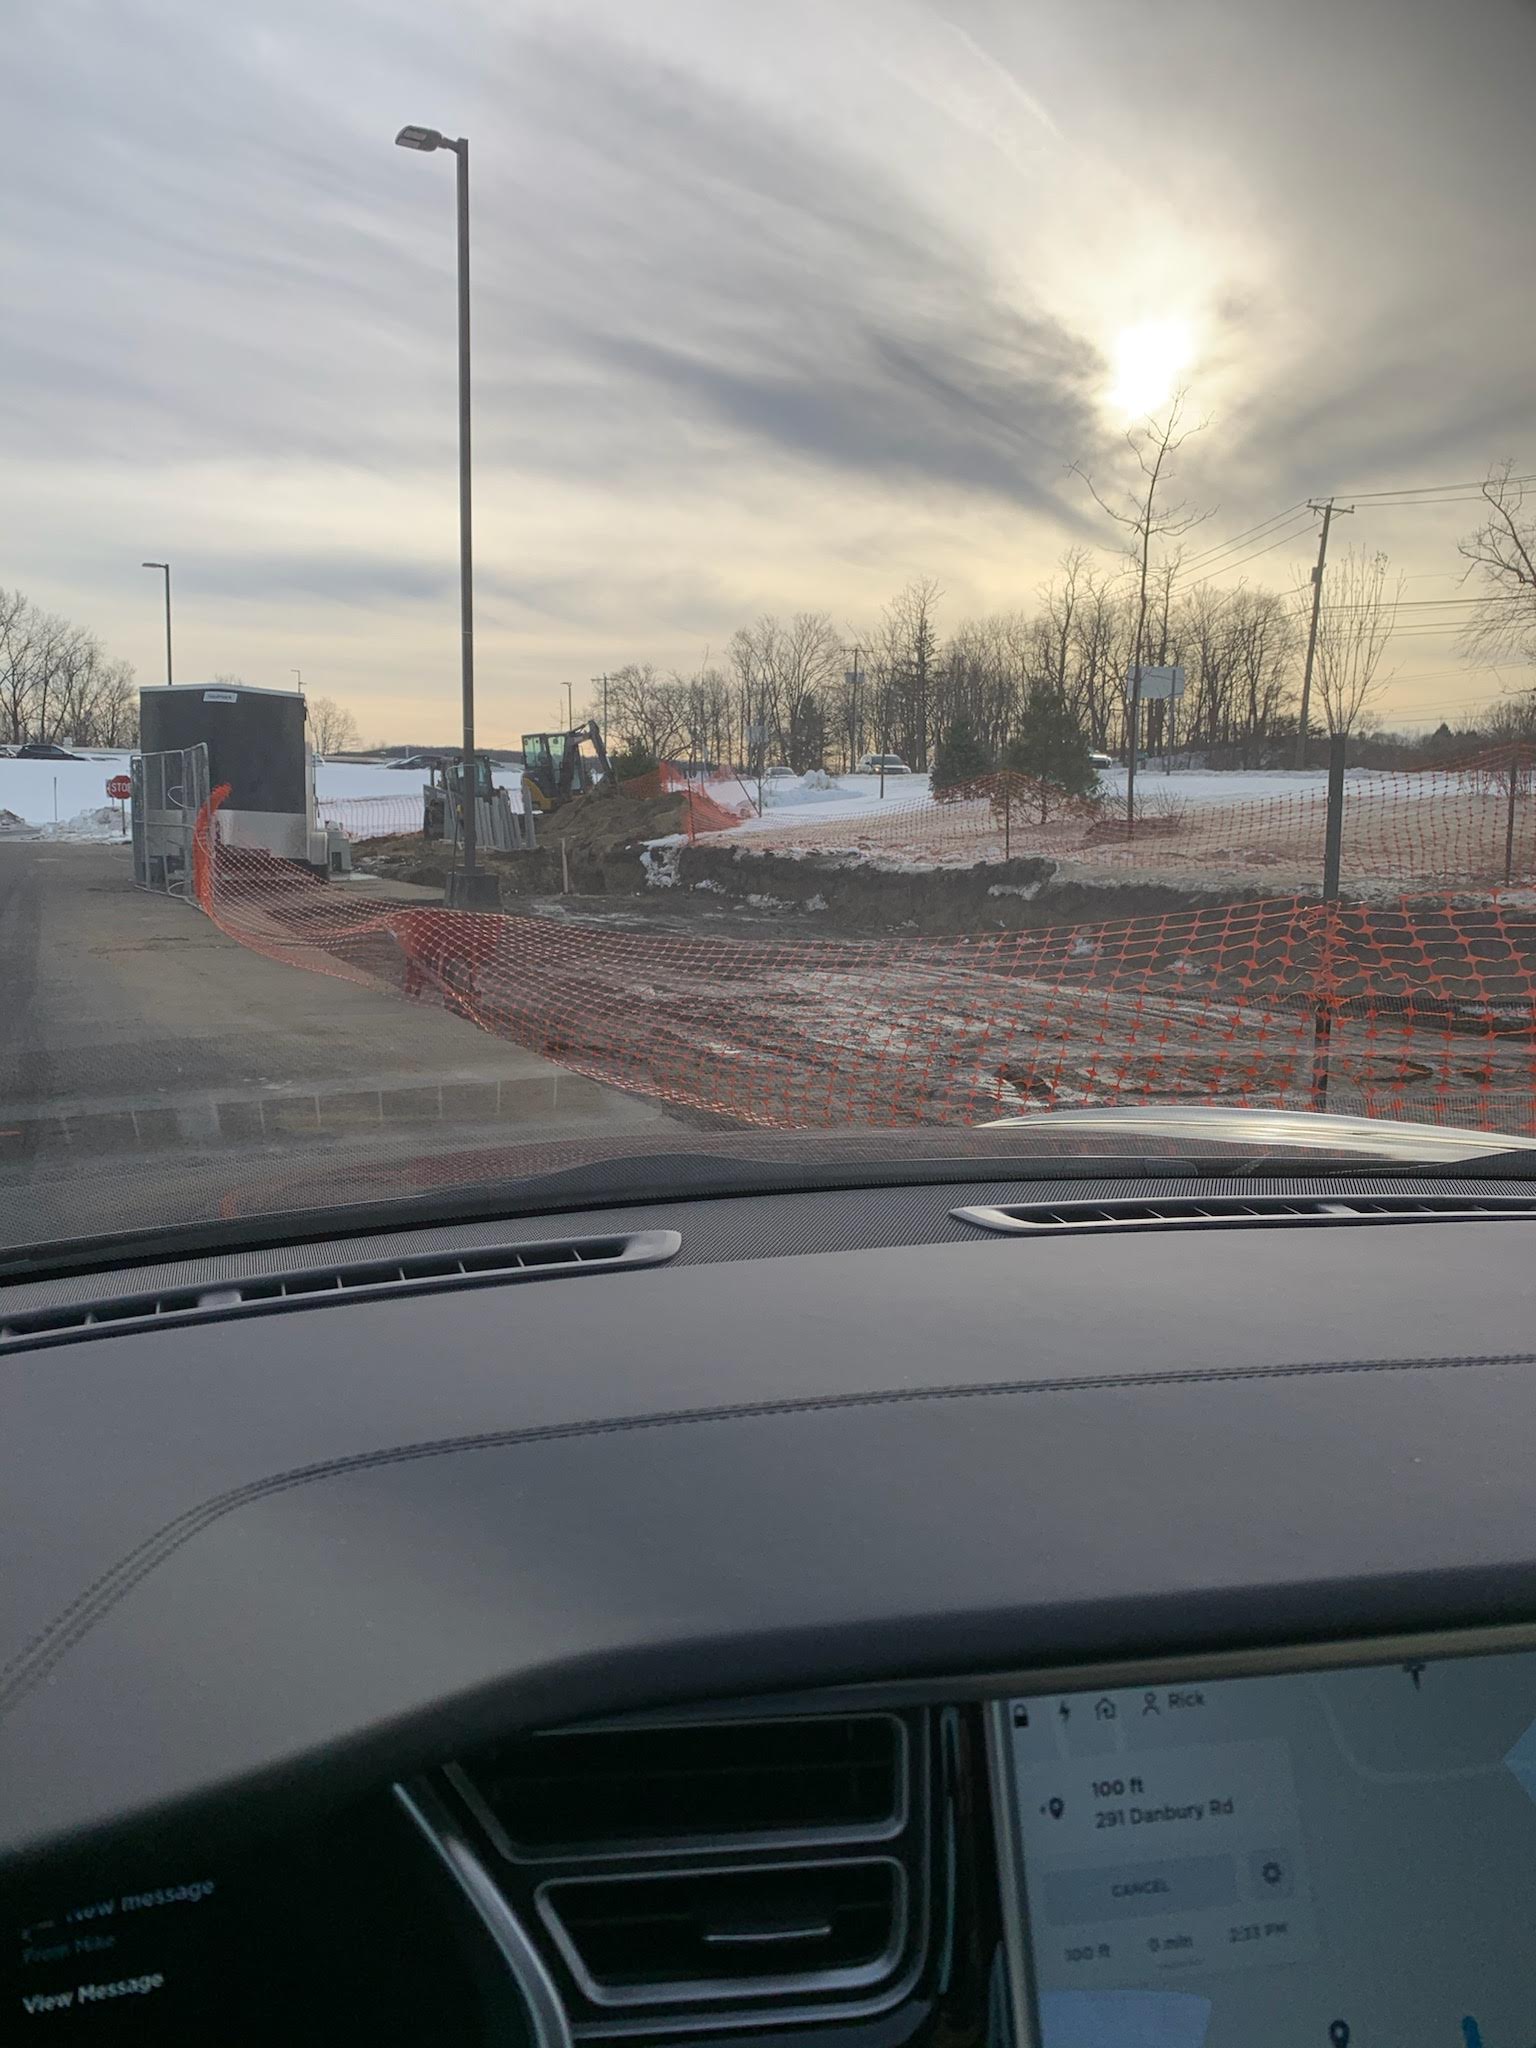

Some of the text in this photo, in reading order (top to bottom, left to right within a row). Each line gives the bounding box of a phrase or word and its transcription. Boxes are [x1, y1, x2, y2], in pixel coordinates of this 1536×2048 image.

[111, 782, 131, 793] STO
[1168, 1691, 1205, 1709] Rick
[1092, 1778, 1145, 1797] 100 ft
[1095, 1799, 1234, 1829] 291 Danbury Rd
[121, 1879, 216, 1912] message
[1111, 1878, 1170, 1898] CANCEL
[1264, 1922, 1289, 1938] PM
[22, 1972, 165, 2015] View Message
